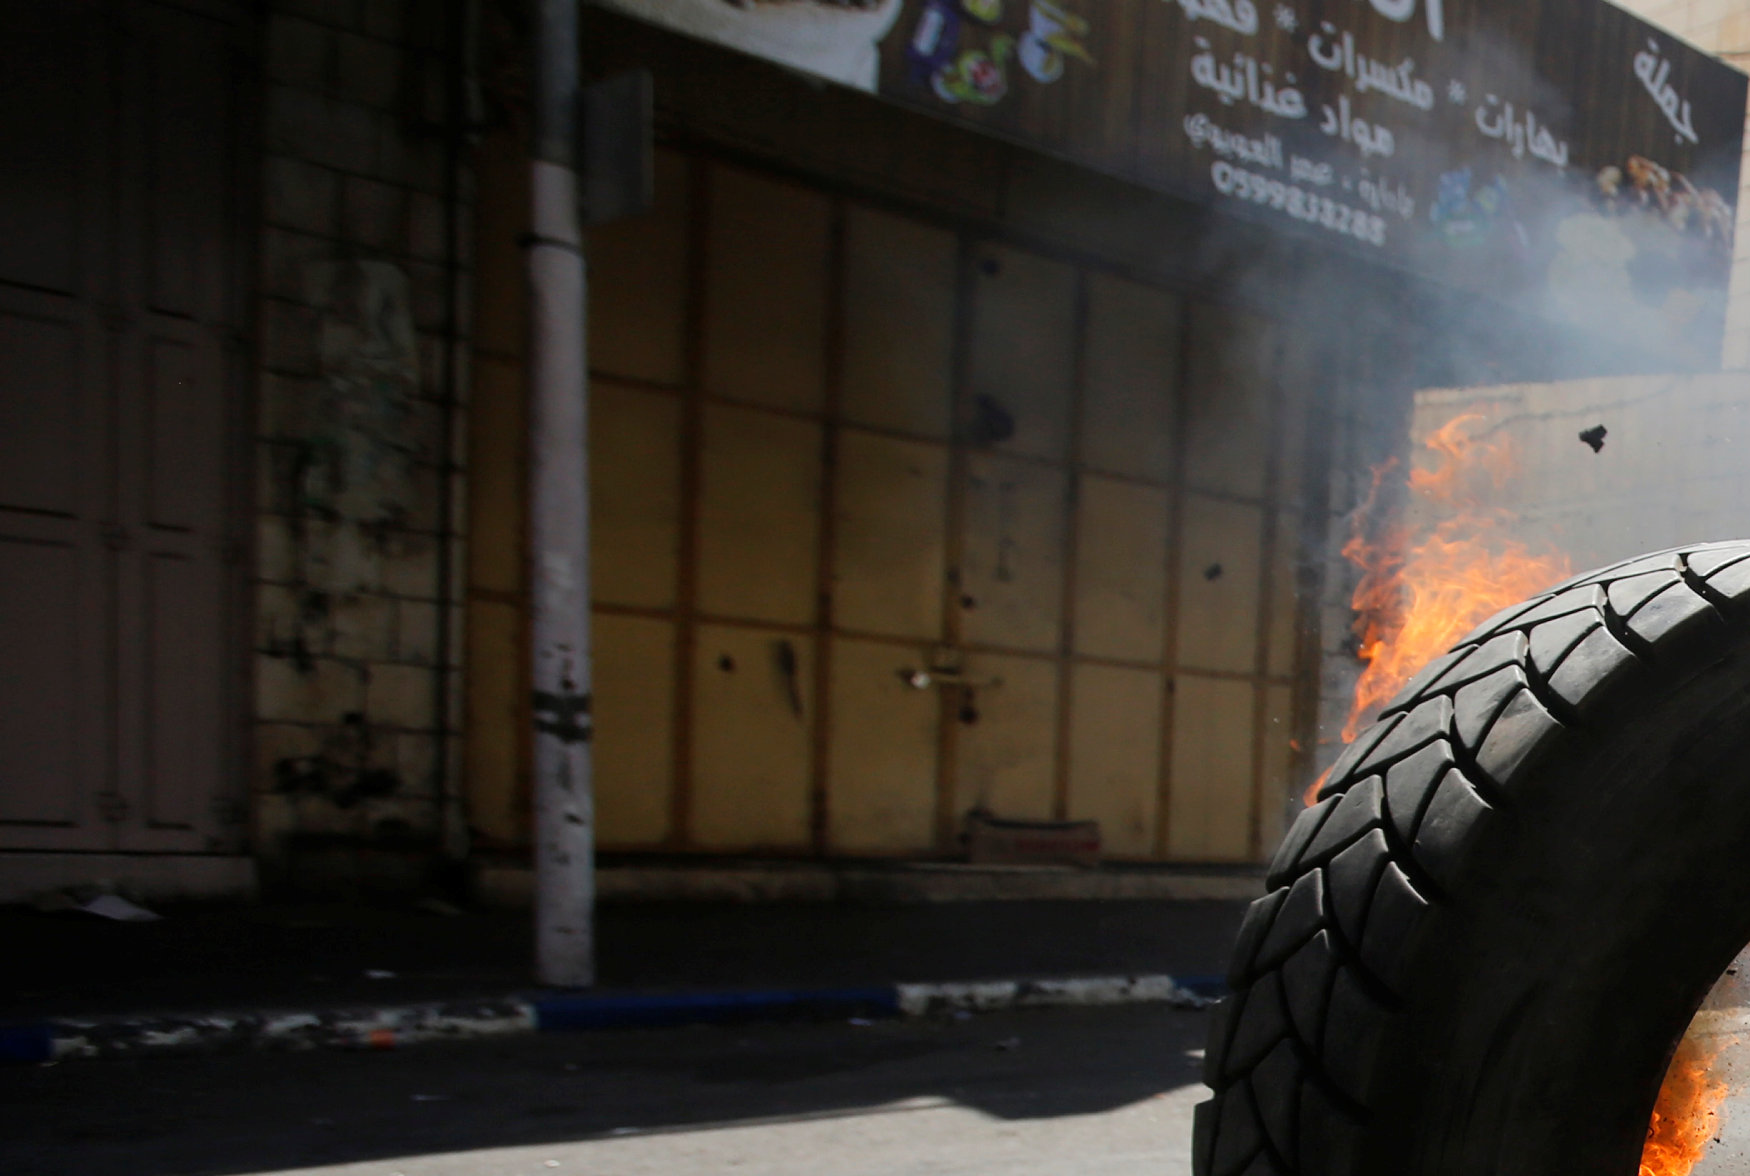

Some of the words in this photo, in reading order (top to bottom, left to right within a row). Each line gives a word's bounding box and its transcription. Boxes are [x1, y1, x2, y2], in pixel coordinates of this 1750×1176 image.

[1190, 35, 1308, 119] غذائية
[1307, 20, 1435, 111] مكسرات
[1319, 93, 1396, 158] مواد
